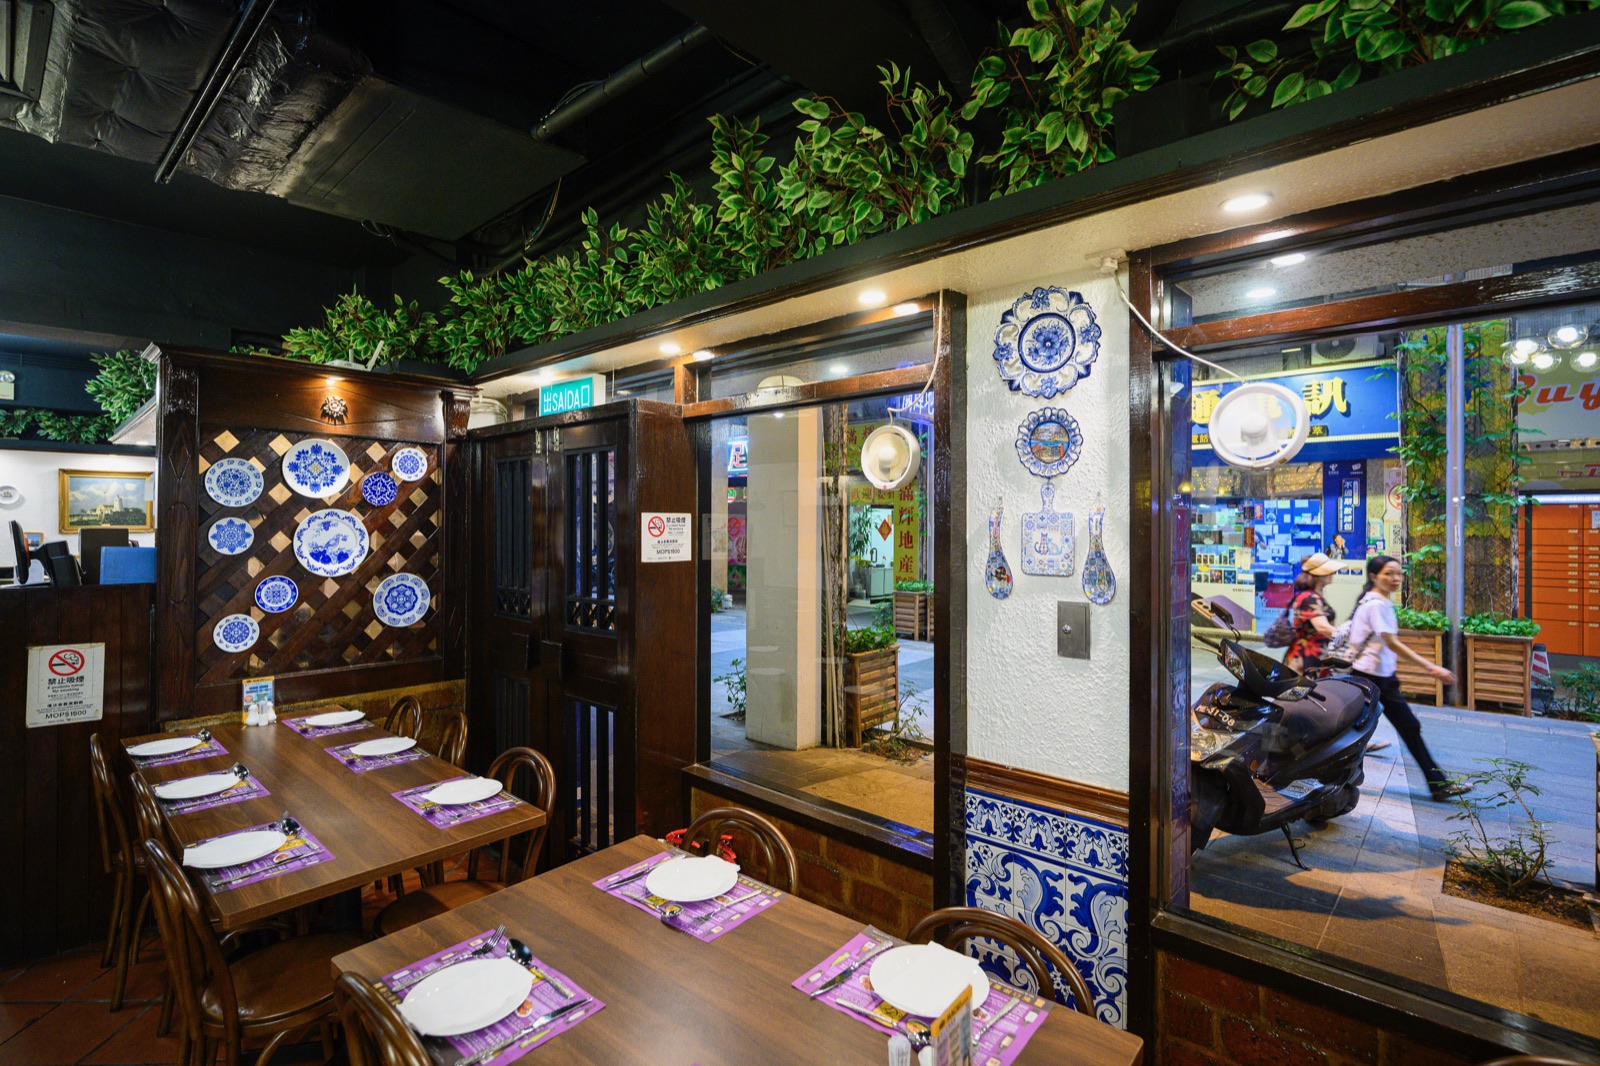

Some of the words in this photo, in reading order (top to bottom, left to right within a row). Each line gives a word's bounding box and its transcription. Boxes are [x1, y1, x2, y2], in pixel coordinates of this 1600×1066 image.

[552, 387, 580, 412] SAÍDA
[48, 675, 85, 685] 禁止吸煙
